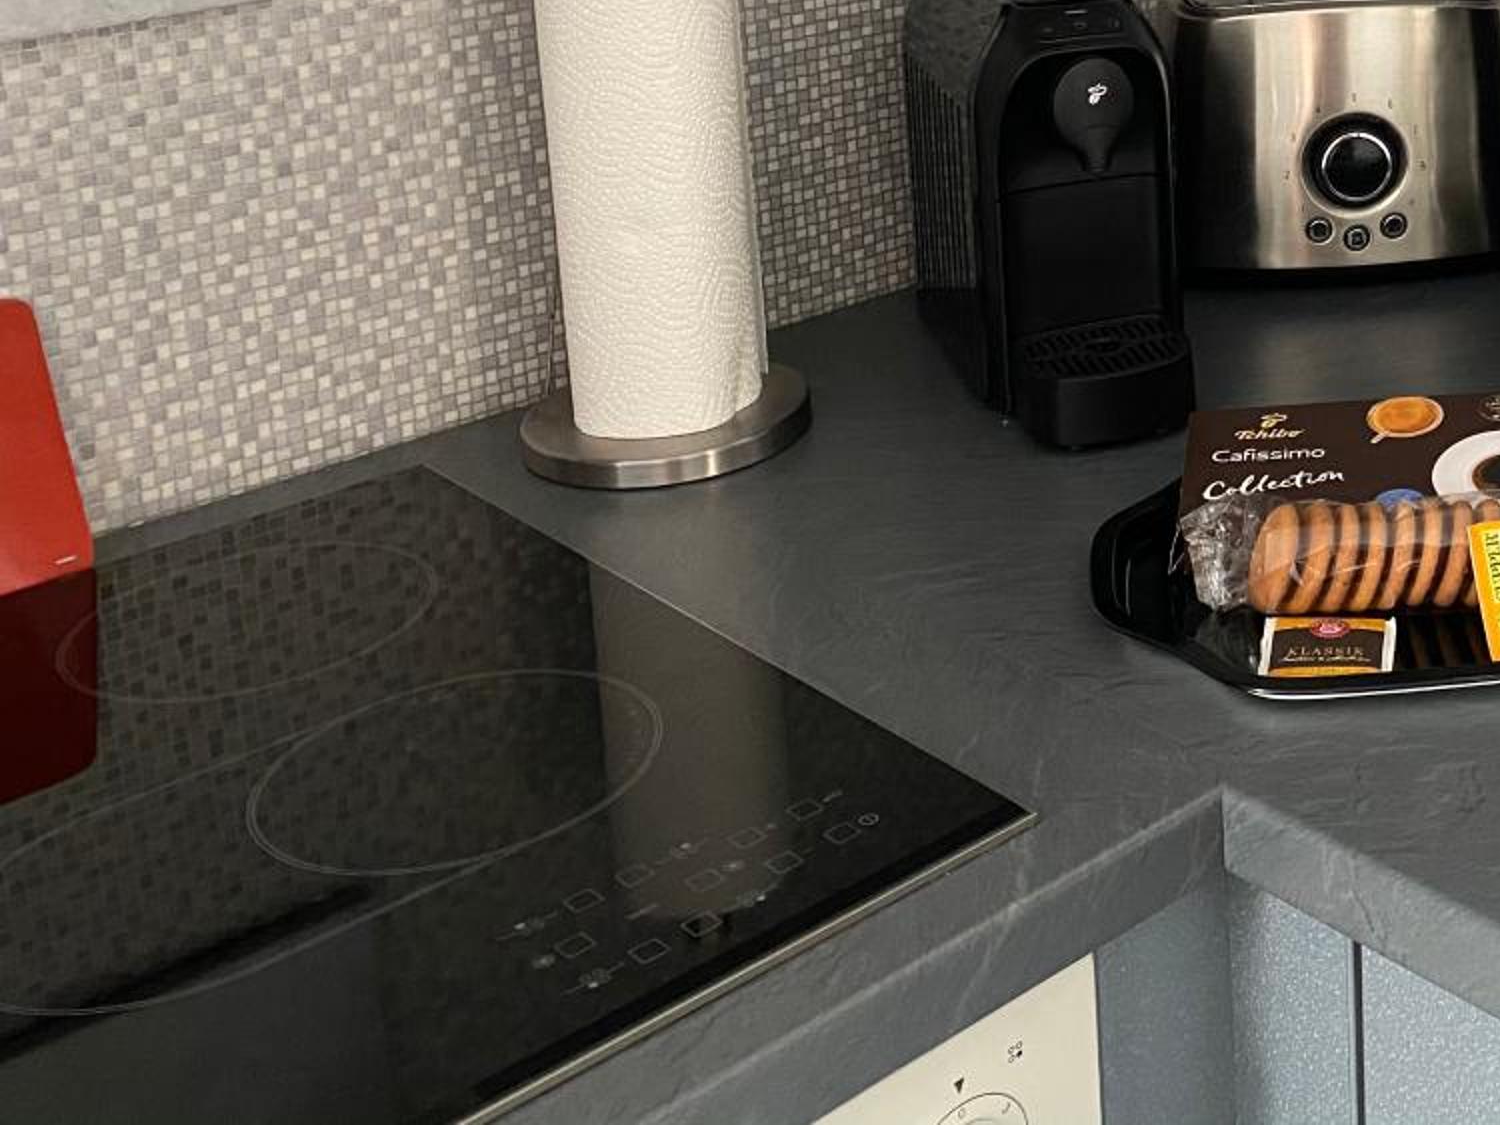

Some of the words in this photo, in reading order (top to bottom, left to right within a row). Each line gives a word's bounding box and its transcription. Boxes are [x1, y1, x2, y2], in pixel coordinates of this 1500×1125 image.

[1234, 428, 1306, 441] Tchibo
[1211, 448, 1326, 463] Cafissimo
[1202, 470, 1345, 501] Collection
